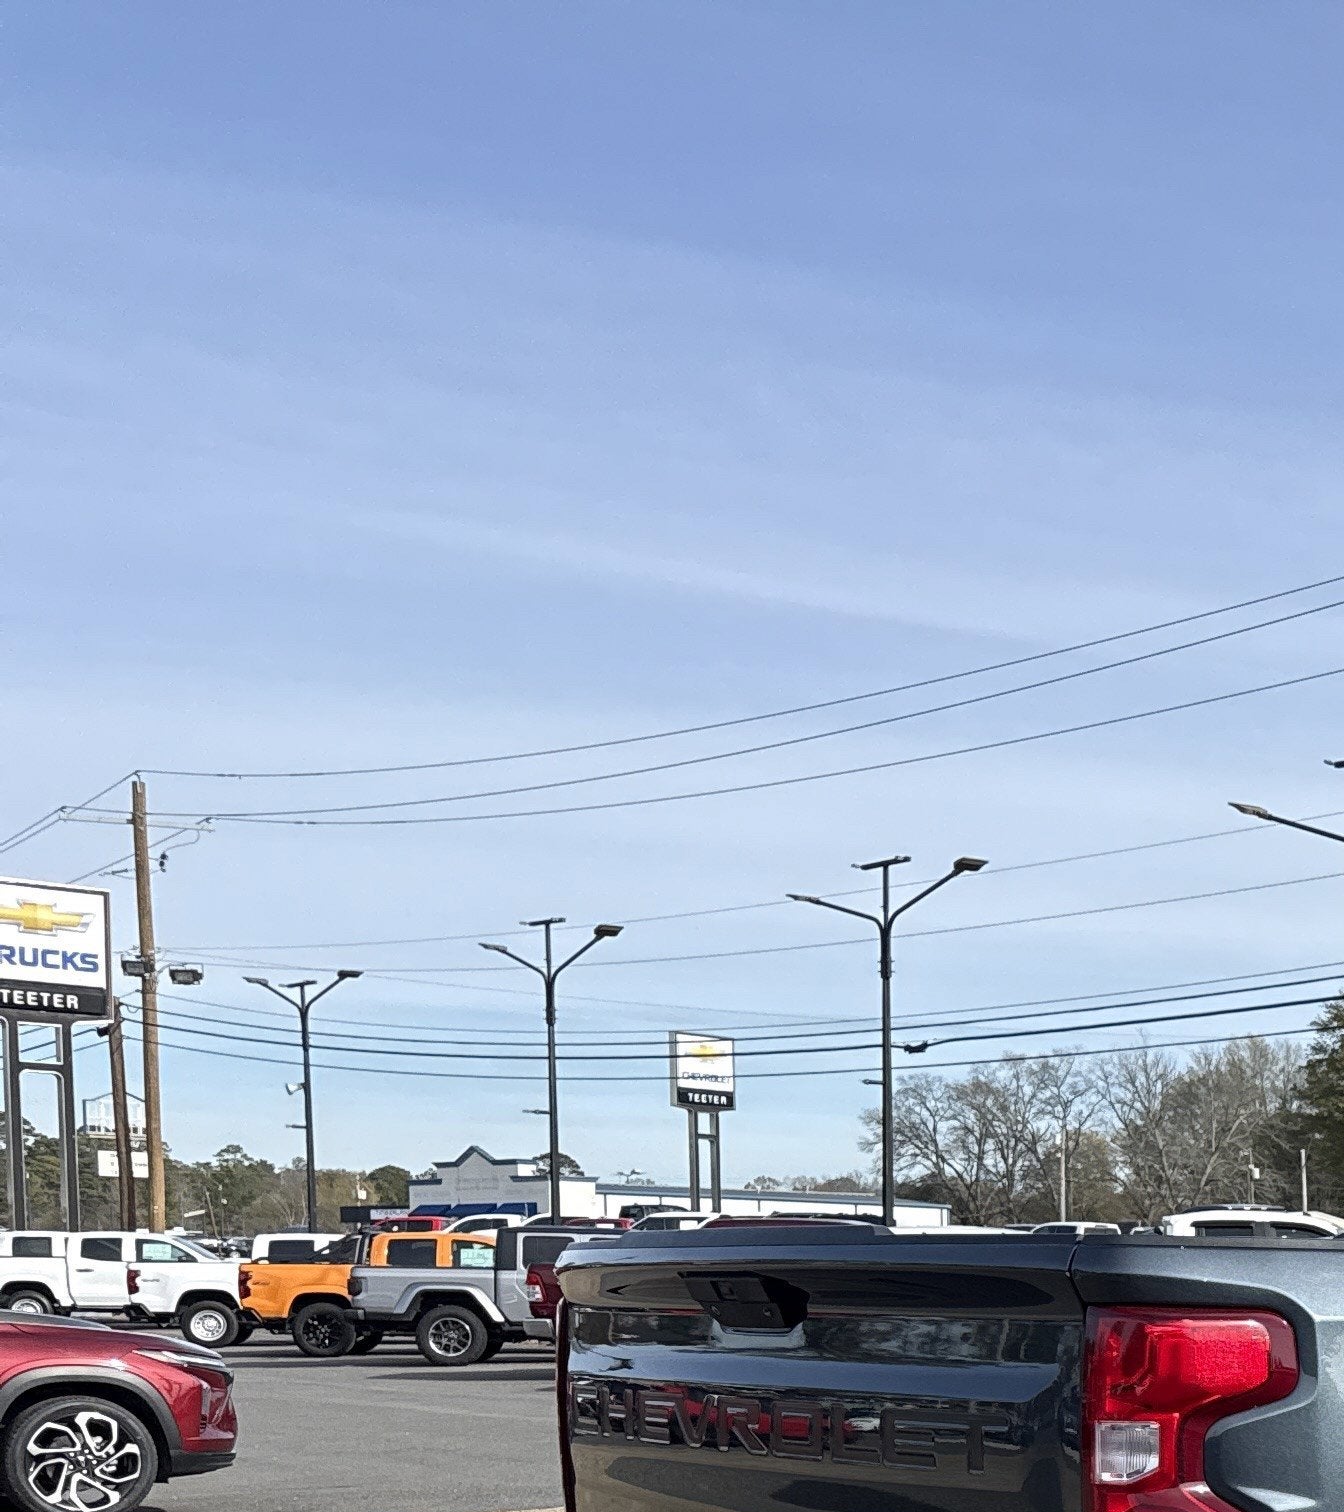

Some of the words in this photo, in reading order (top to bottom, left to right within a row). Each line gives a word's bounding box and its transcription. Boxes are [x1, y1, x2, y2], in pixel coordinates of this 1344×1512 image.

[0, 988, 79, 1010] TEETER
[688, 1092, 727, 1105] TEETER
[571, 1381, 1010, 1475] CHEVROLET
